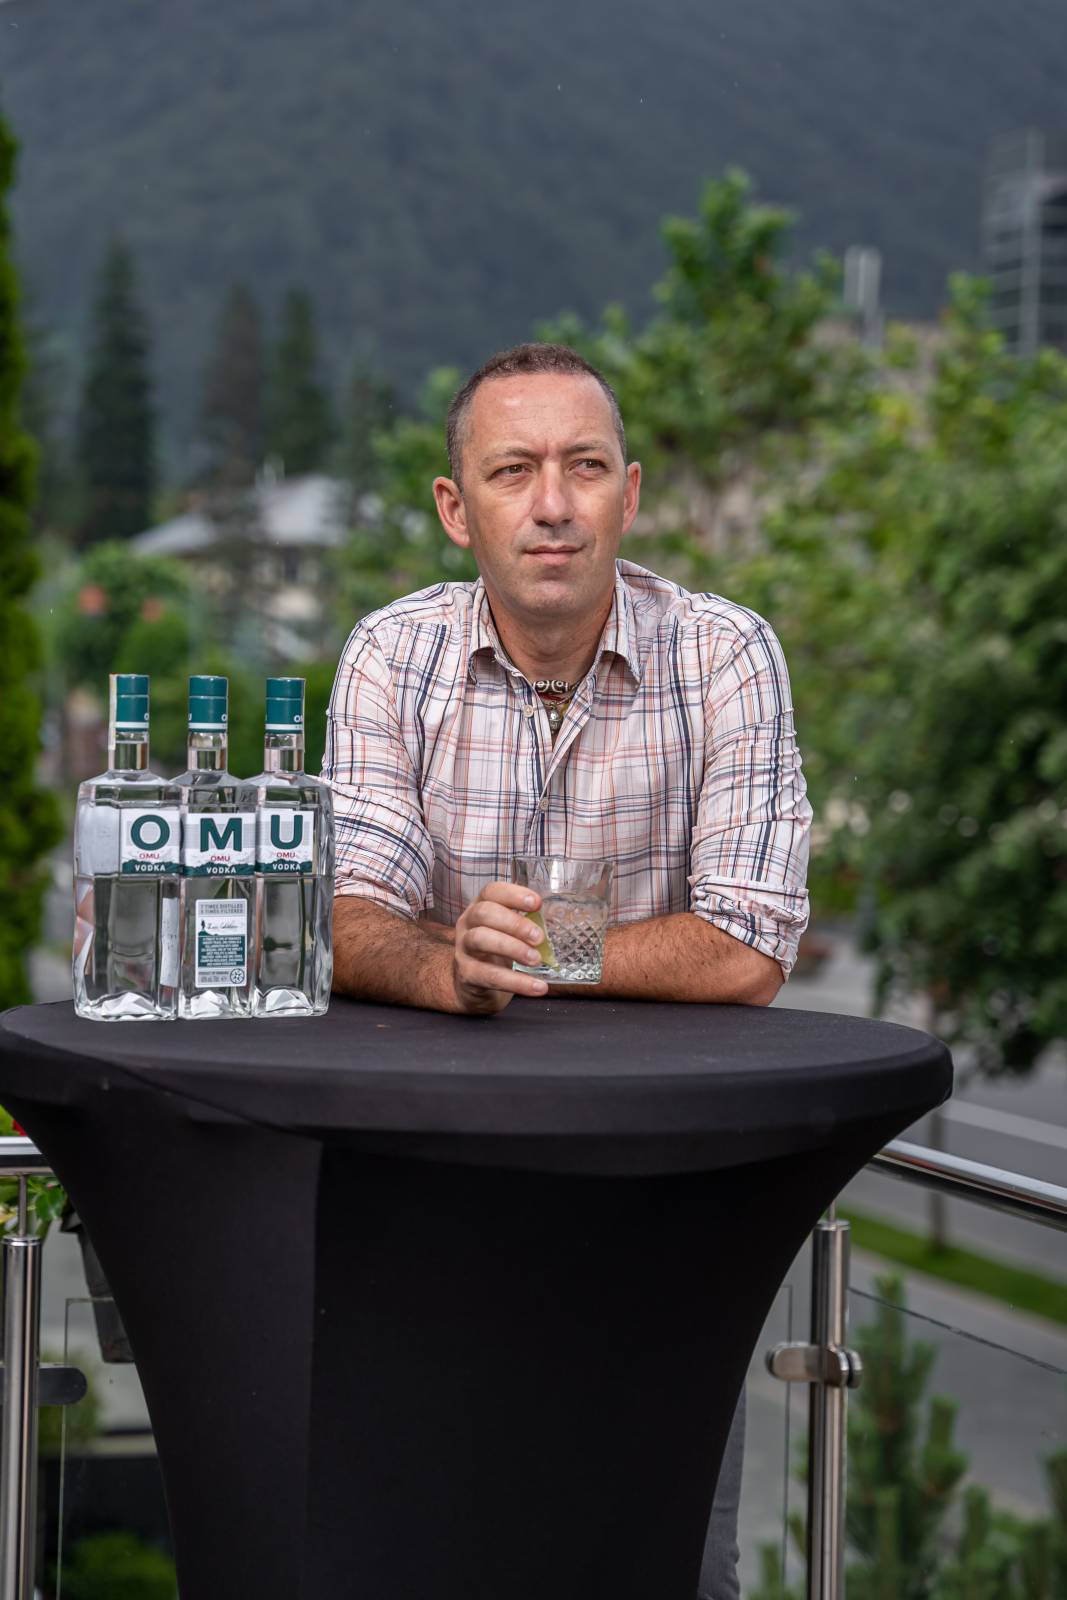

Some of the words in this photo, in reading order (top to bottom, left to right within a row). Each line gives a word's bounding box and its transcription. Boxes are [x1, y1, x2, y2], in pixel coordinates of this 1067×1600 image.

[130, 814, 171, 851] O
[200, 817, 243, 853] M
[270, 814, 304, 850] U
[134, 864, 166, 872] VODKA
[206, 866, 237, 874] VODKA
[272, 863, 301, 871] VODKA
